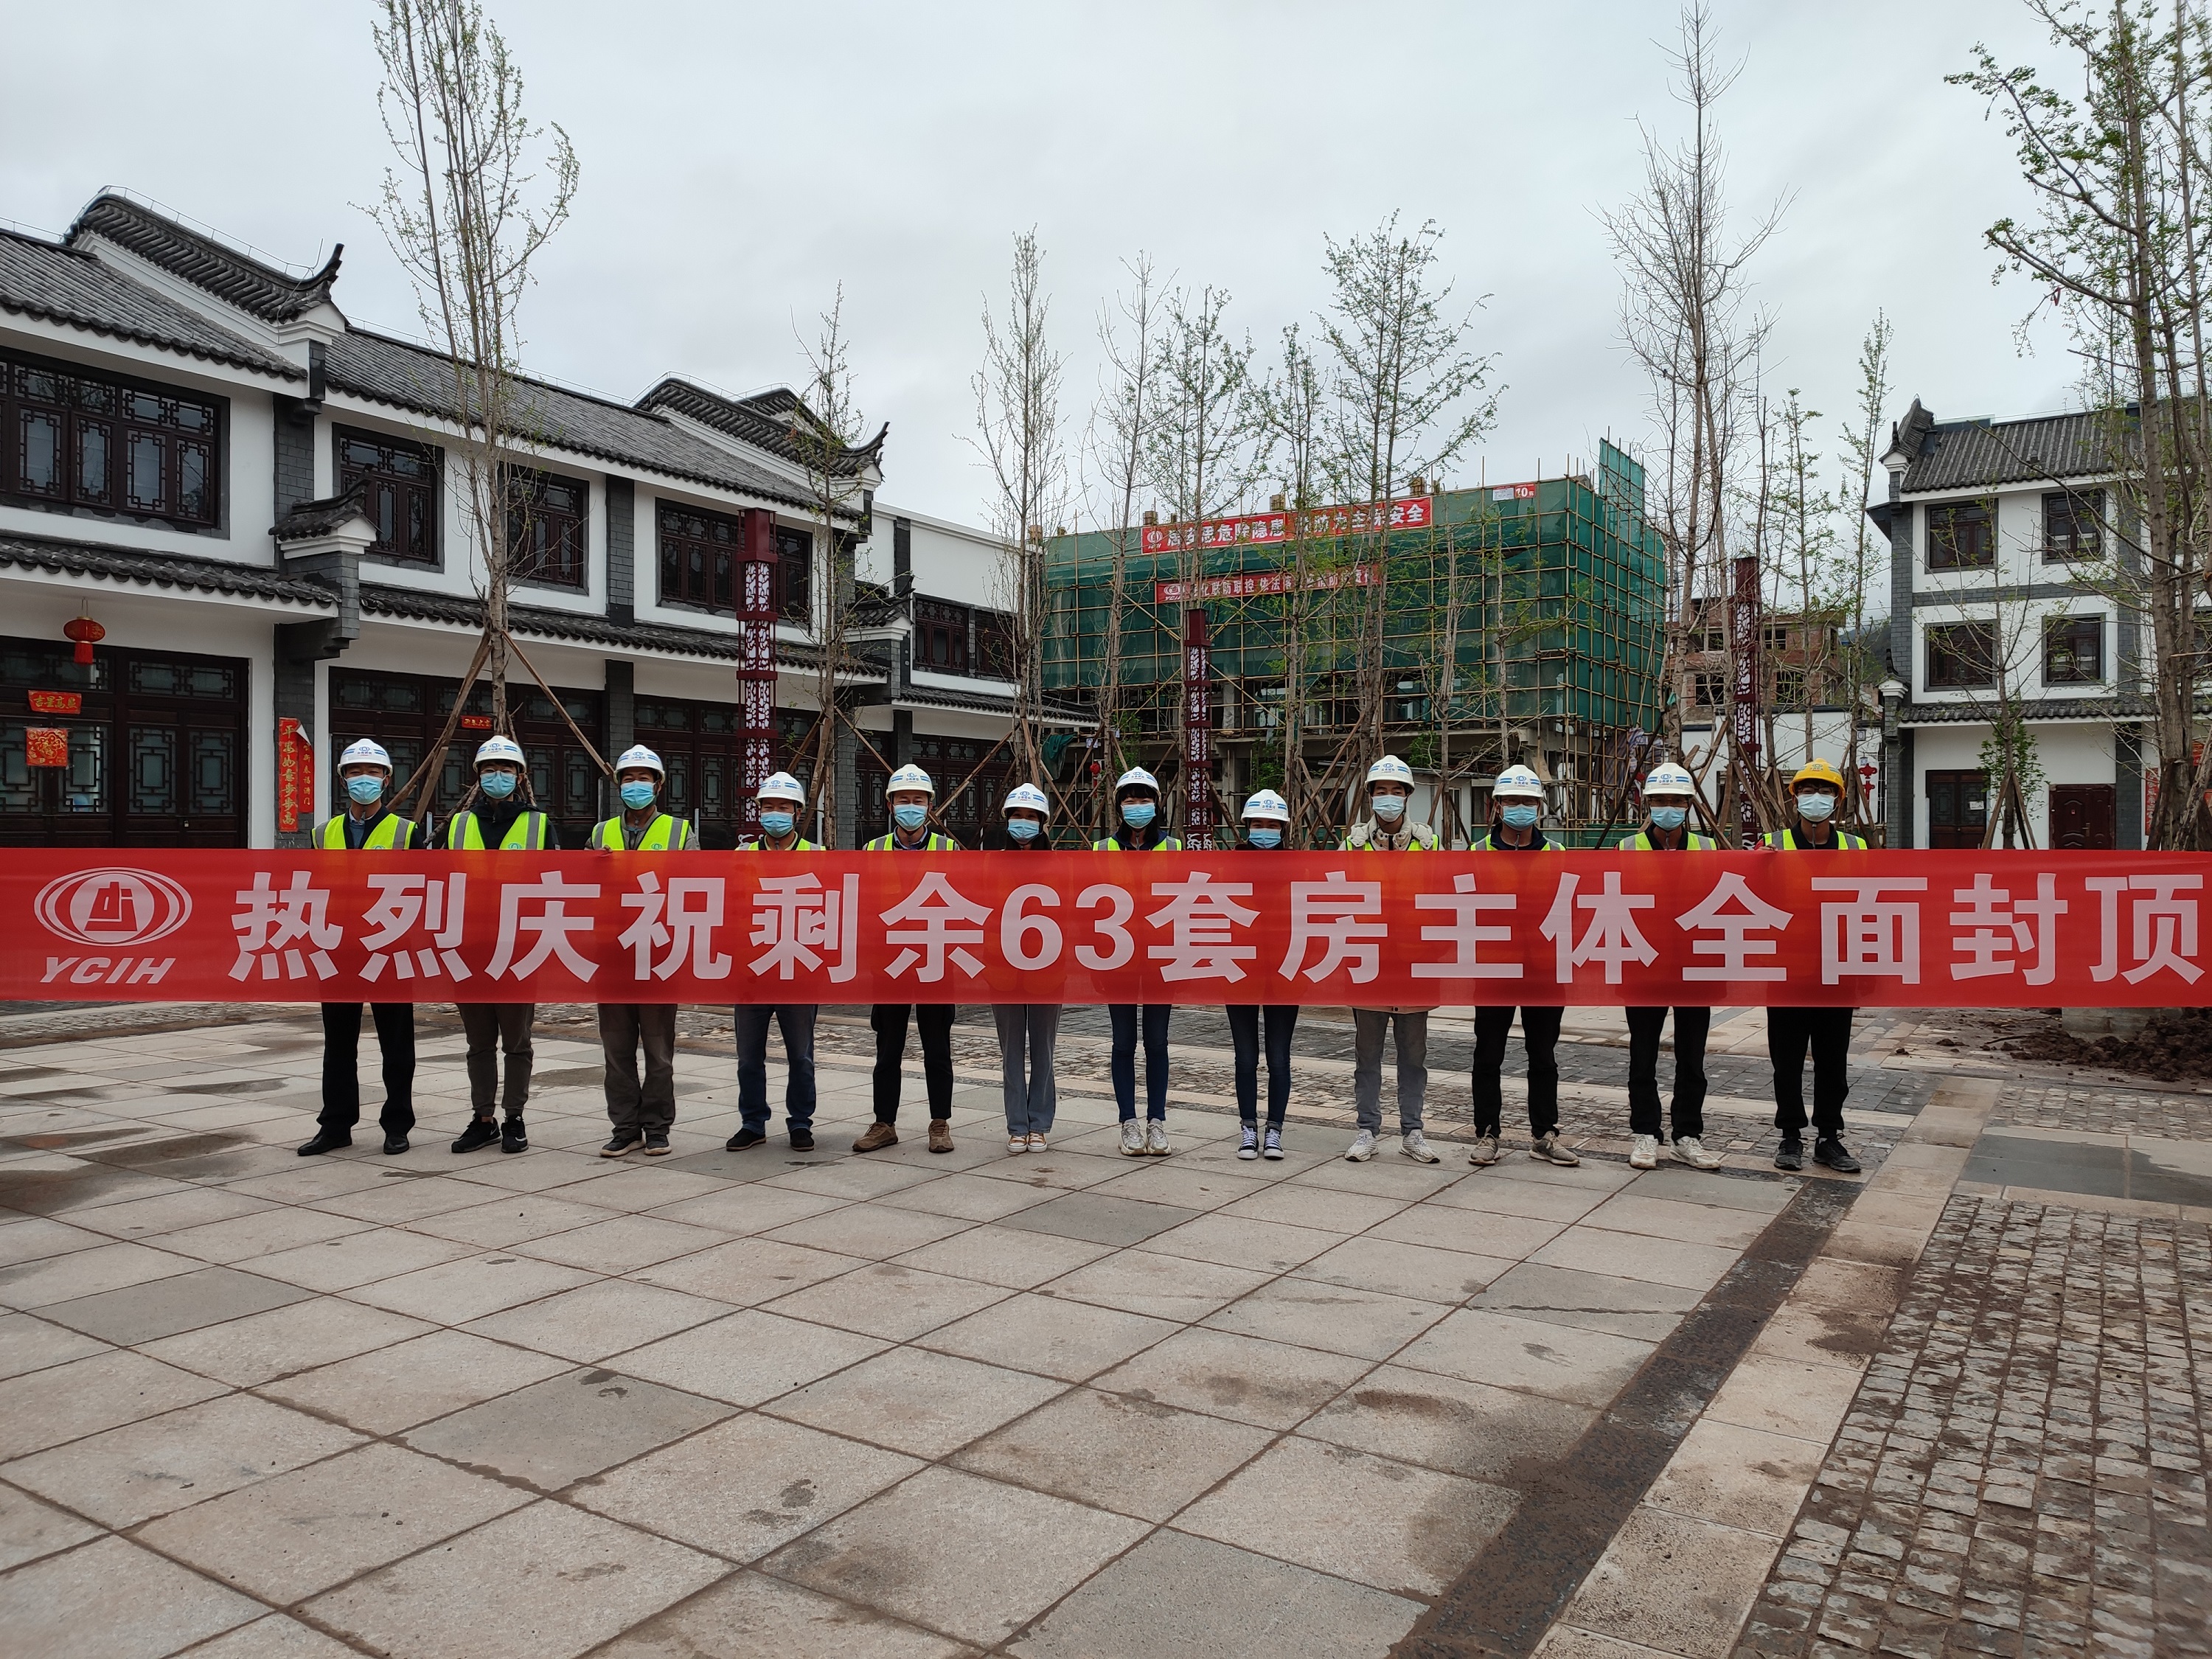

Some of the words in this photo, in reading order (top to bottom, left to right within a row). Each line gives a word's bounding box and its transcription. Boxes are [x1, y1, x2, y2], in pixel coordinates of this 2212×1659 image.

[282, 725, 298, 824] 平安如意步步高
[40, 957, 176, 984] YCIH
[228, 870, 2205, 986] 热烈庆祝剩余63套房主体全面封顶
